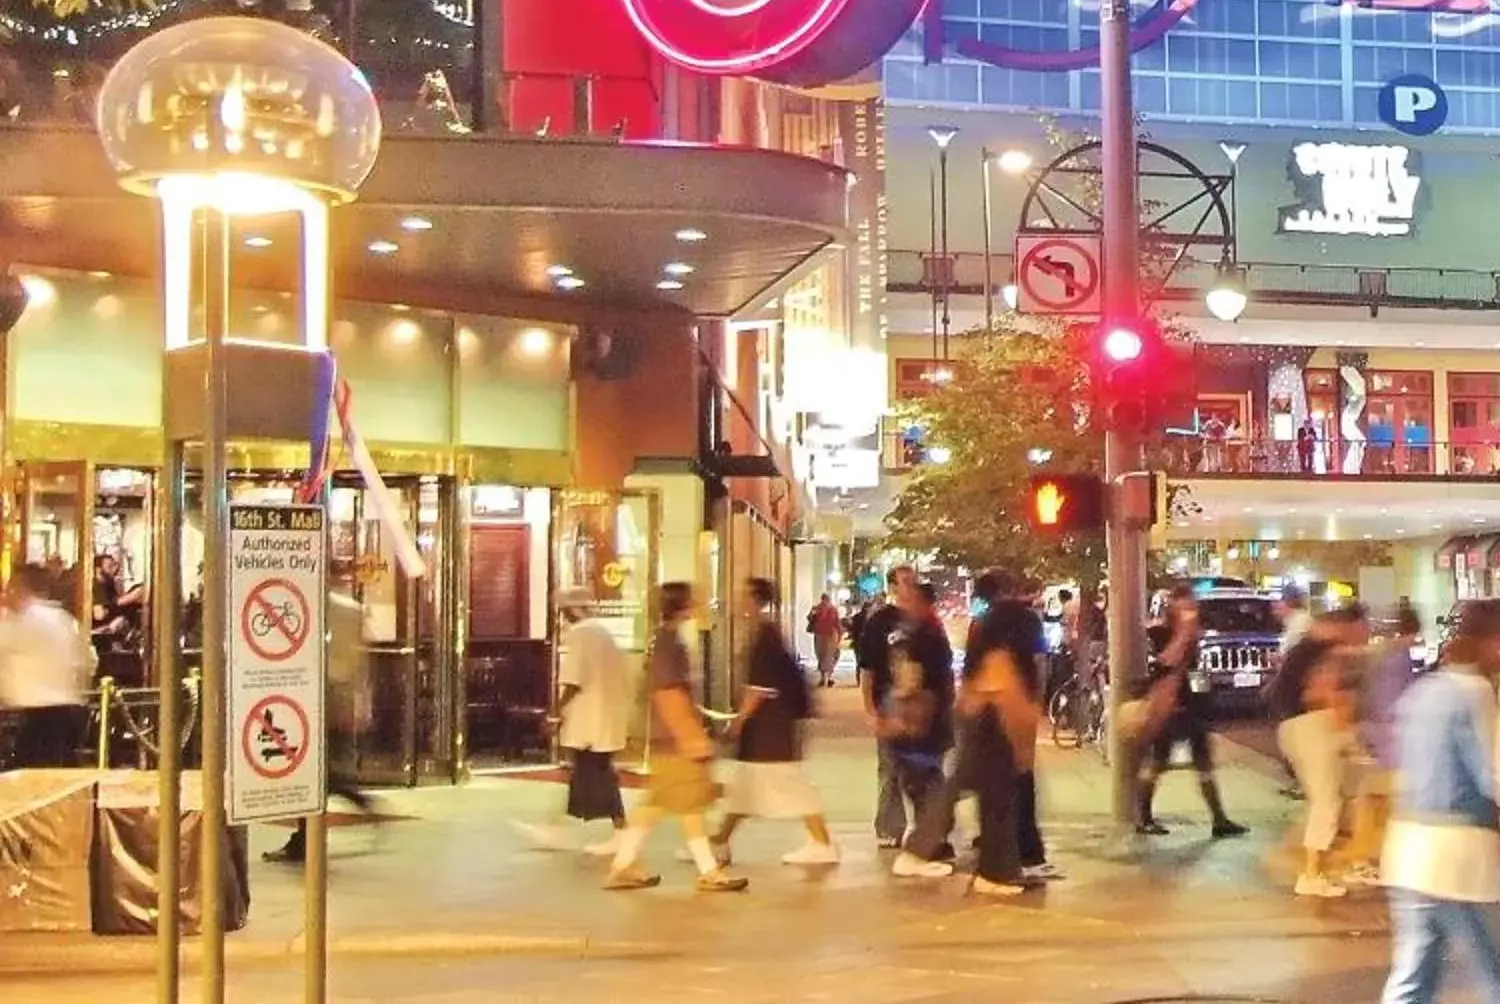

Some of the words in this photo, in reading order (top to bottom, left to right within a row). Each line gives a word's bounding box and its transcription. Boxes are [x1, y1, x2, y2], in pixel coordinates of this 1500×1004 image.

[857, 218, 871, 266] FALL
[858, 275, 872, 313] THE
[233, 510, 264, 529] 16th
[290, 511, 321, 529] Mall
[241, 536, 311, 551] Authorized
[235, 554, 285, 570] Vehicles
[289, 555, 317, 573] Only
